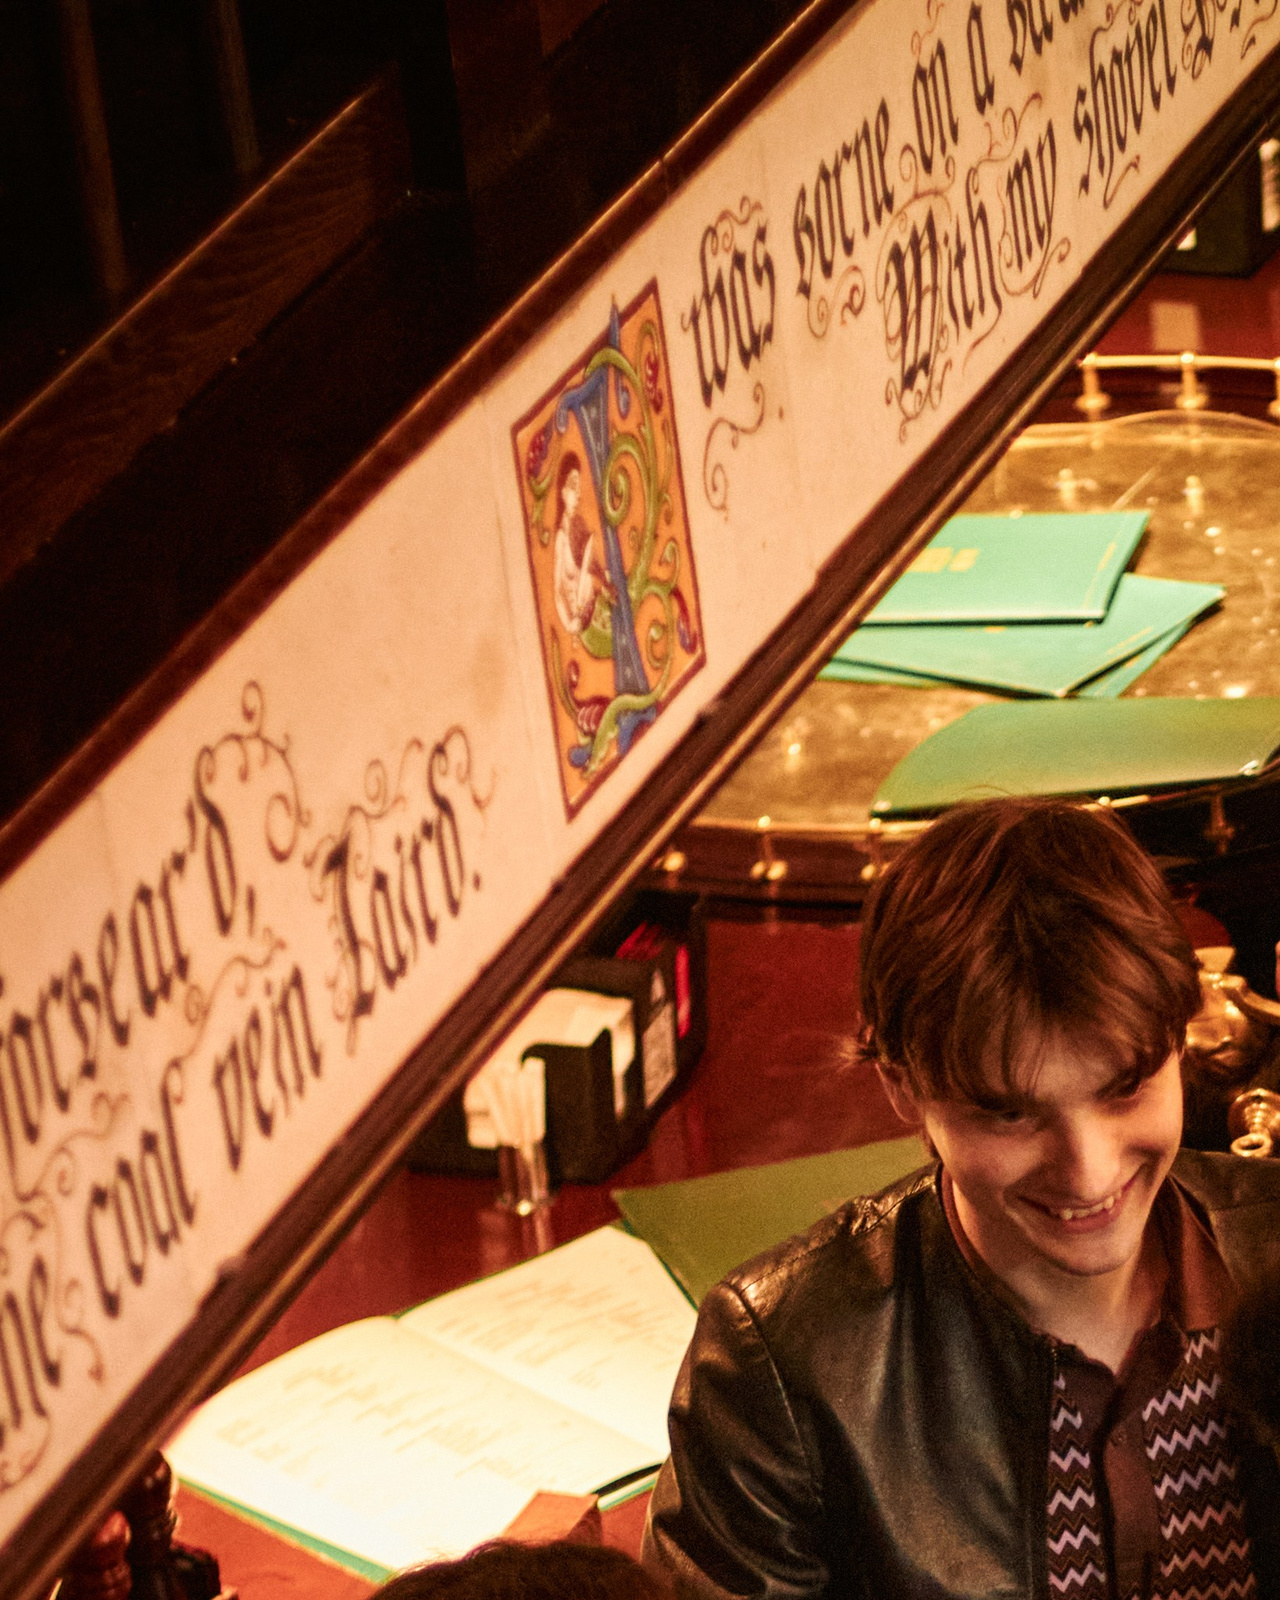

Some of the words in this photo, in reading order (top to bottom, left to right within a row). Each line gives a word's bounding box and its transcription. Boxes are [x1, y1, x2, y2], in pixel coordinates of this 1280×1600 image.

[793, 96, 895, 301] borne
[911, 38, 959, 177] on
[965, 0, 995, 117] a
[883, 166, 1003, 395] With
[1005, 117, 1058, 300] my
[1072, 0, 1178, 205] shovel
[85, 1060, 198, 1319] coal
[212, 962, 323, 1174] vein
